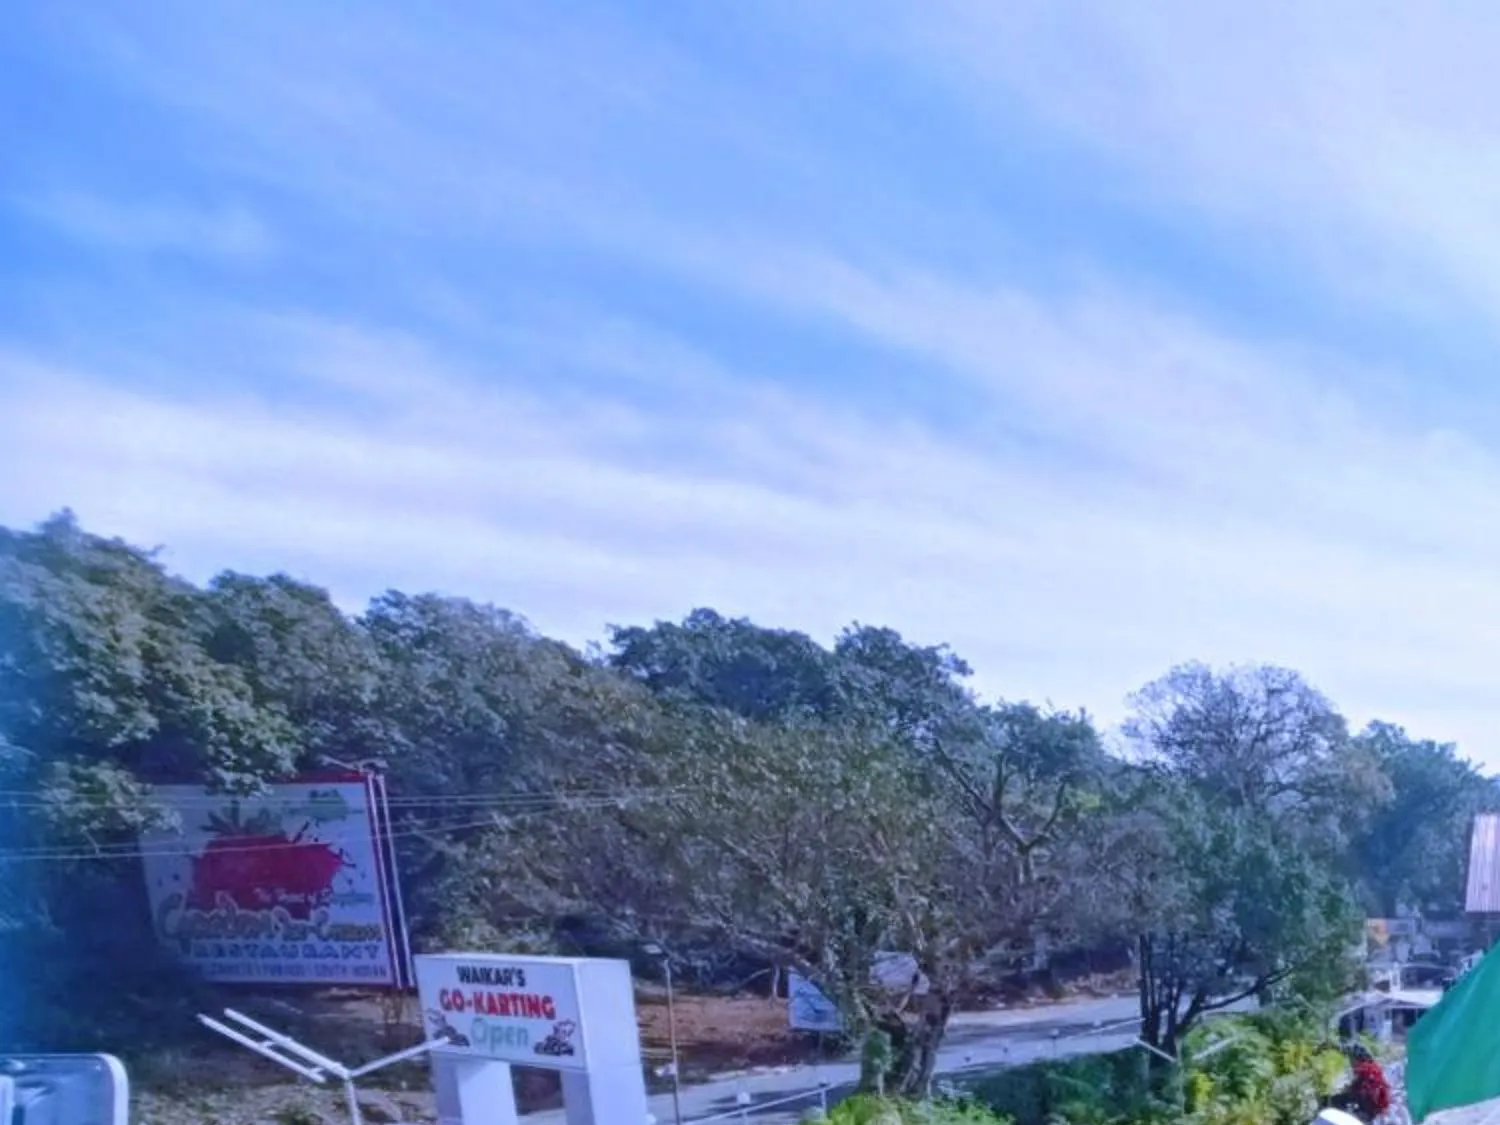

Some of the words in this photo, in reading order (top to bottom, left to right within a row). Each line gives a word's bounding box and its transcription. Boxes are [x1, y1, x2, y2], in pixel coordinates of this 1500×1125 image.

[456, 965, 528, 988] WAIKAR'S
[439, 987, 558, 1020] GO-KARTING
[470, 1016, 529, 1053] Open
